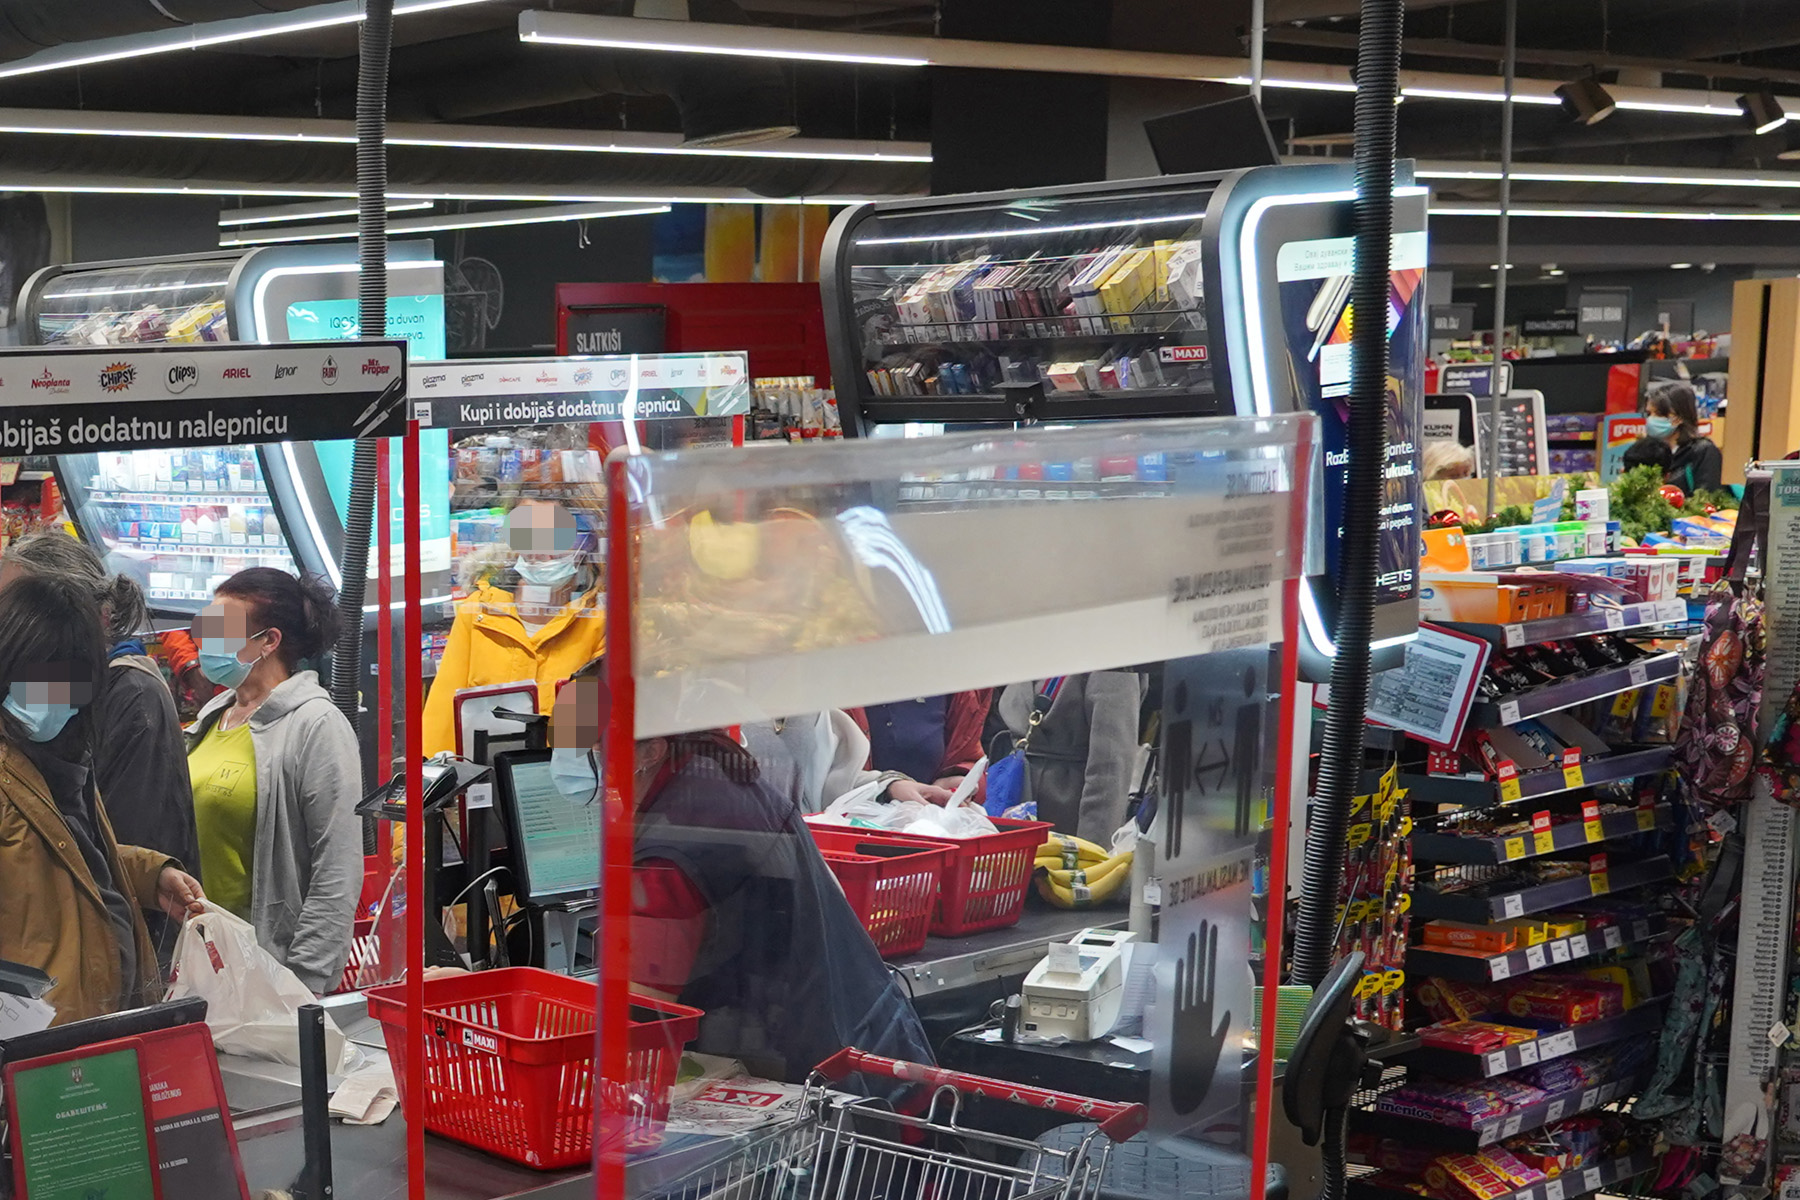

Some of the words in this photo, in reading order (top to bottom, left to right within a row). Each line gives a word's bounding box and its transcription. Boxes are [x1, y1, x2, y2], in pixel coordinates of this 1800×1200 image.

[397, 314, 425, 325] duvan
[576, 332, 622, 353] SLATKIŠI
[1175, 348, 1205, 359] MAXI
[167, 365, 197, 383] Clipsy
[222, 367, 252, 379] ARIEL
[273, 363, 299, 380] Lenor
[321, 366, 339, 380] FAIRY
[361, 363, 390, 375] Proper
[30, 378, 71, 392] Neoplanta
[460, 403, 494, 425] Kupi
[496, 403, 501, 420] i
[503, 400, 555, 424] dobijaš
[557, 398, 615, 418] dodatnu
[68, 416, 172, 445] dodatnu
[180, 410, 289, 443] nalepnicu
[1385, 460, 1415, 480] ukusi.
[1391, 503, 1414, 514] duvan.
[1389, 517, 1414, 530] pepela.
[1375, 568, 1413, 587] HEETS
[473, 1033, 495, 1050] MAXI
[151, 1088, 182, 1103] ODLOŽENOG
[55, 1102, 108, 1120] ОБАВЕШТЕЊЕ
[1379, 1101, 1434, 1121] mentos
